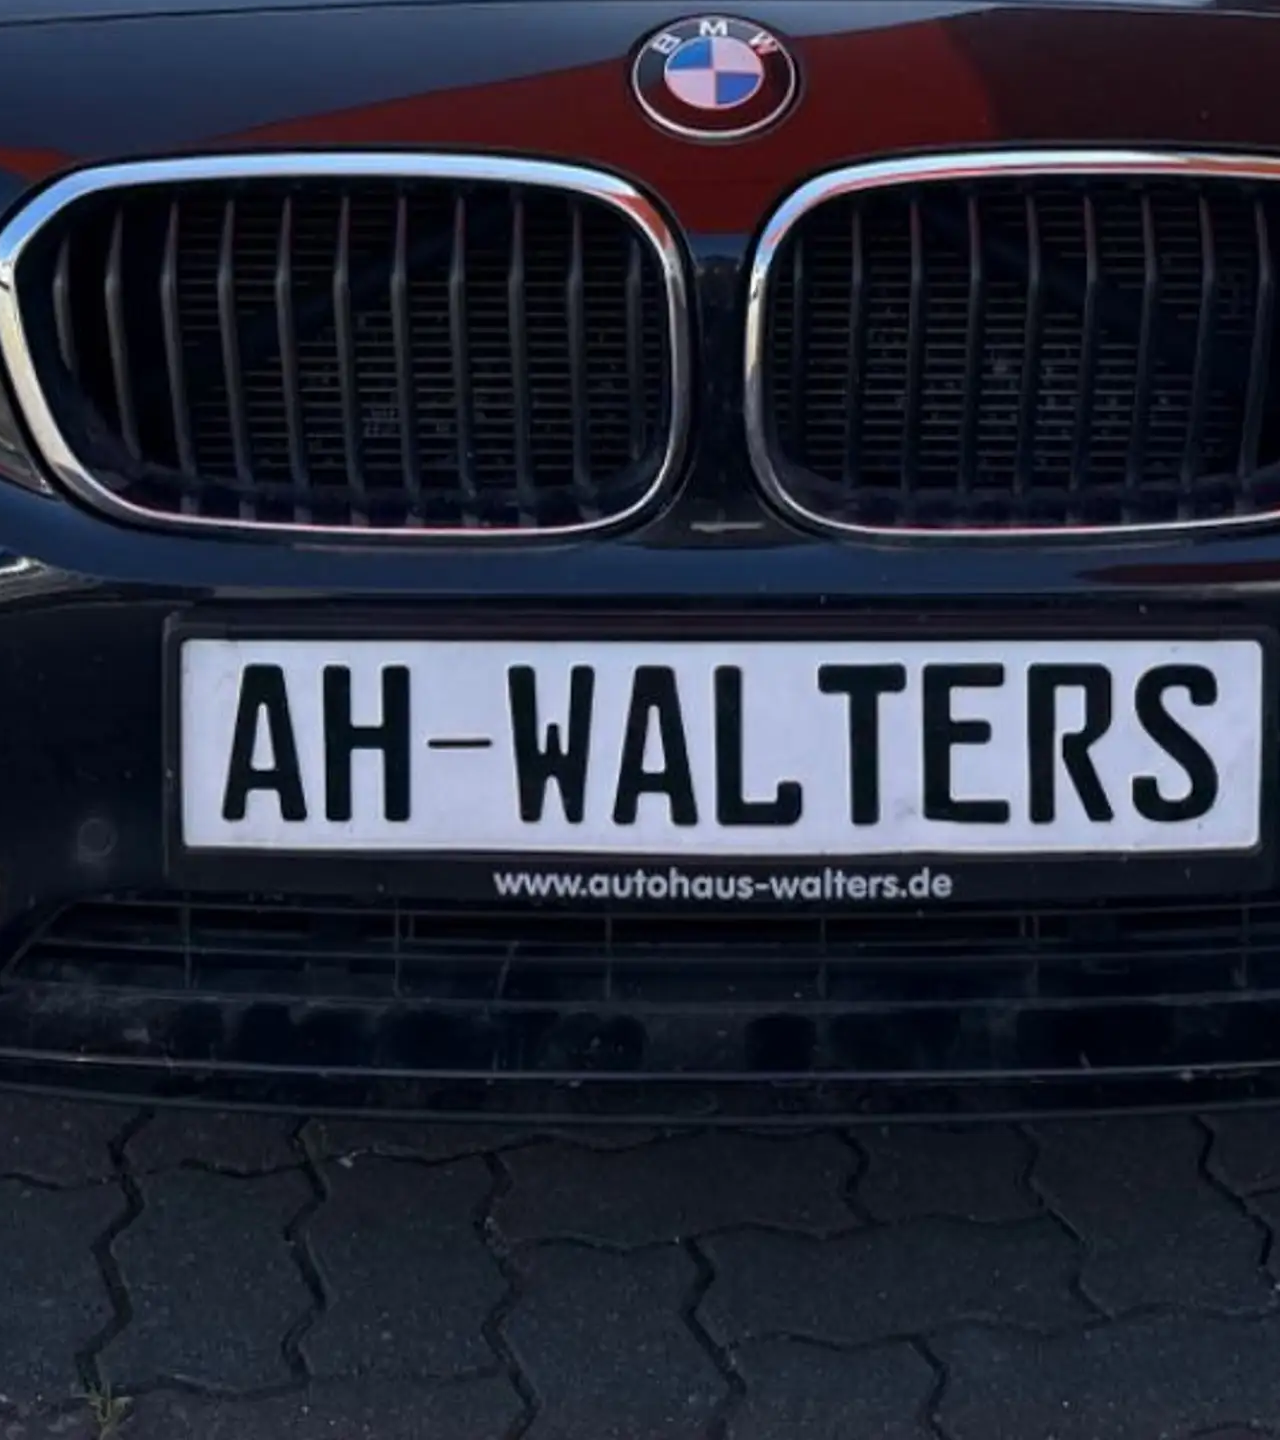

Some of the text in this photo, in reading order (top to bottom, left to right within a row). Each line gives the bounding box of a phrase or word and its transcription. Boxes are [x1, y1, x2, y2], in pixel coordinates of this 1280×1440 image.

[650, 20, 779, 56] BMW
[220, 663, 1220, 825] AH-WALTERS
[492, 867, 954, 900] www.autohaus-walters.de
